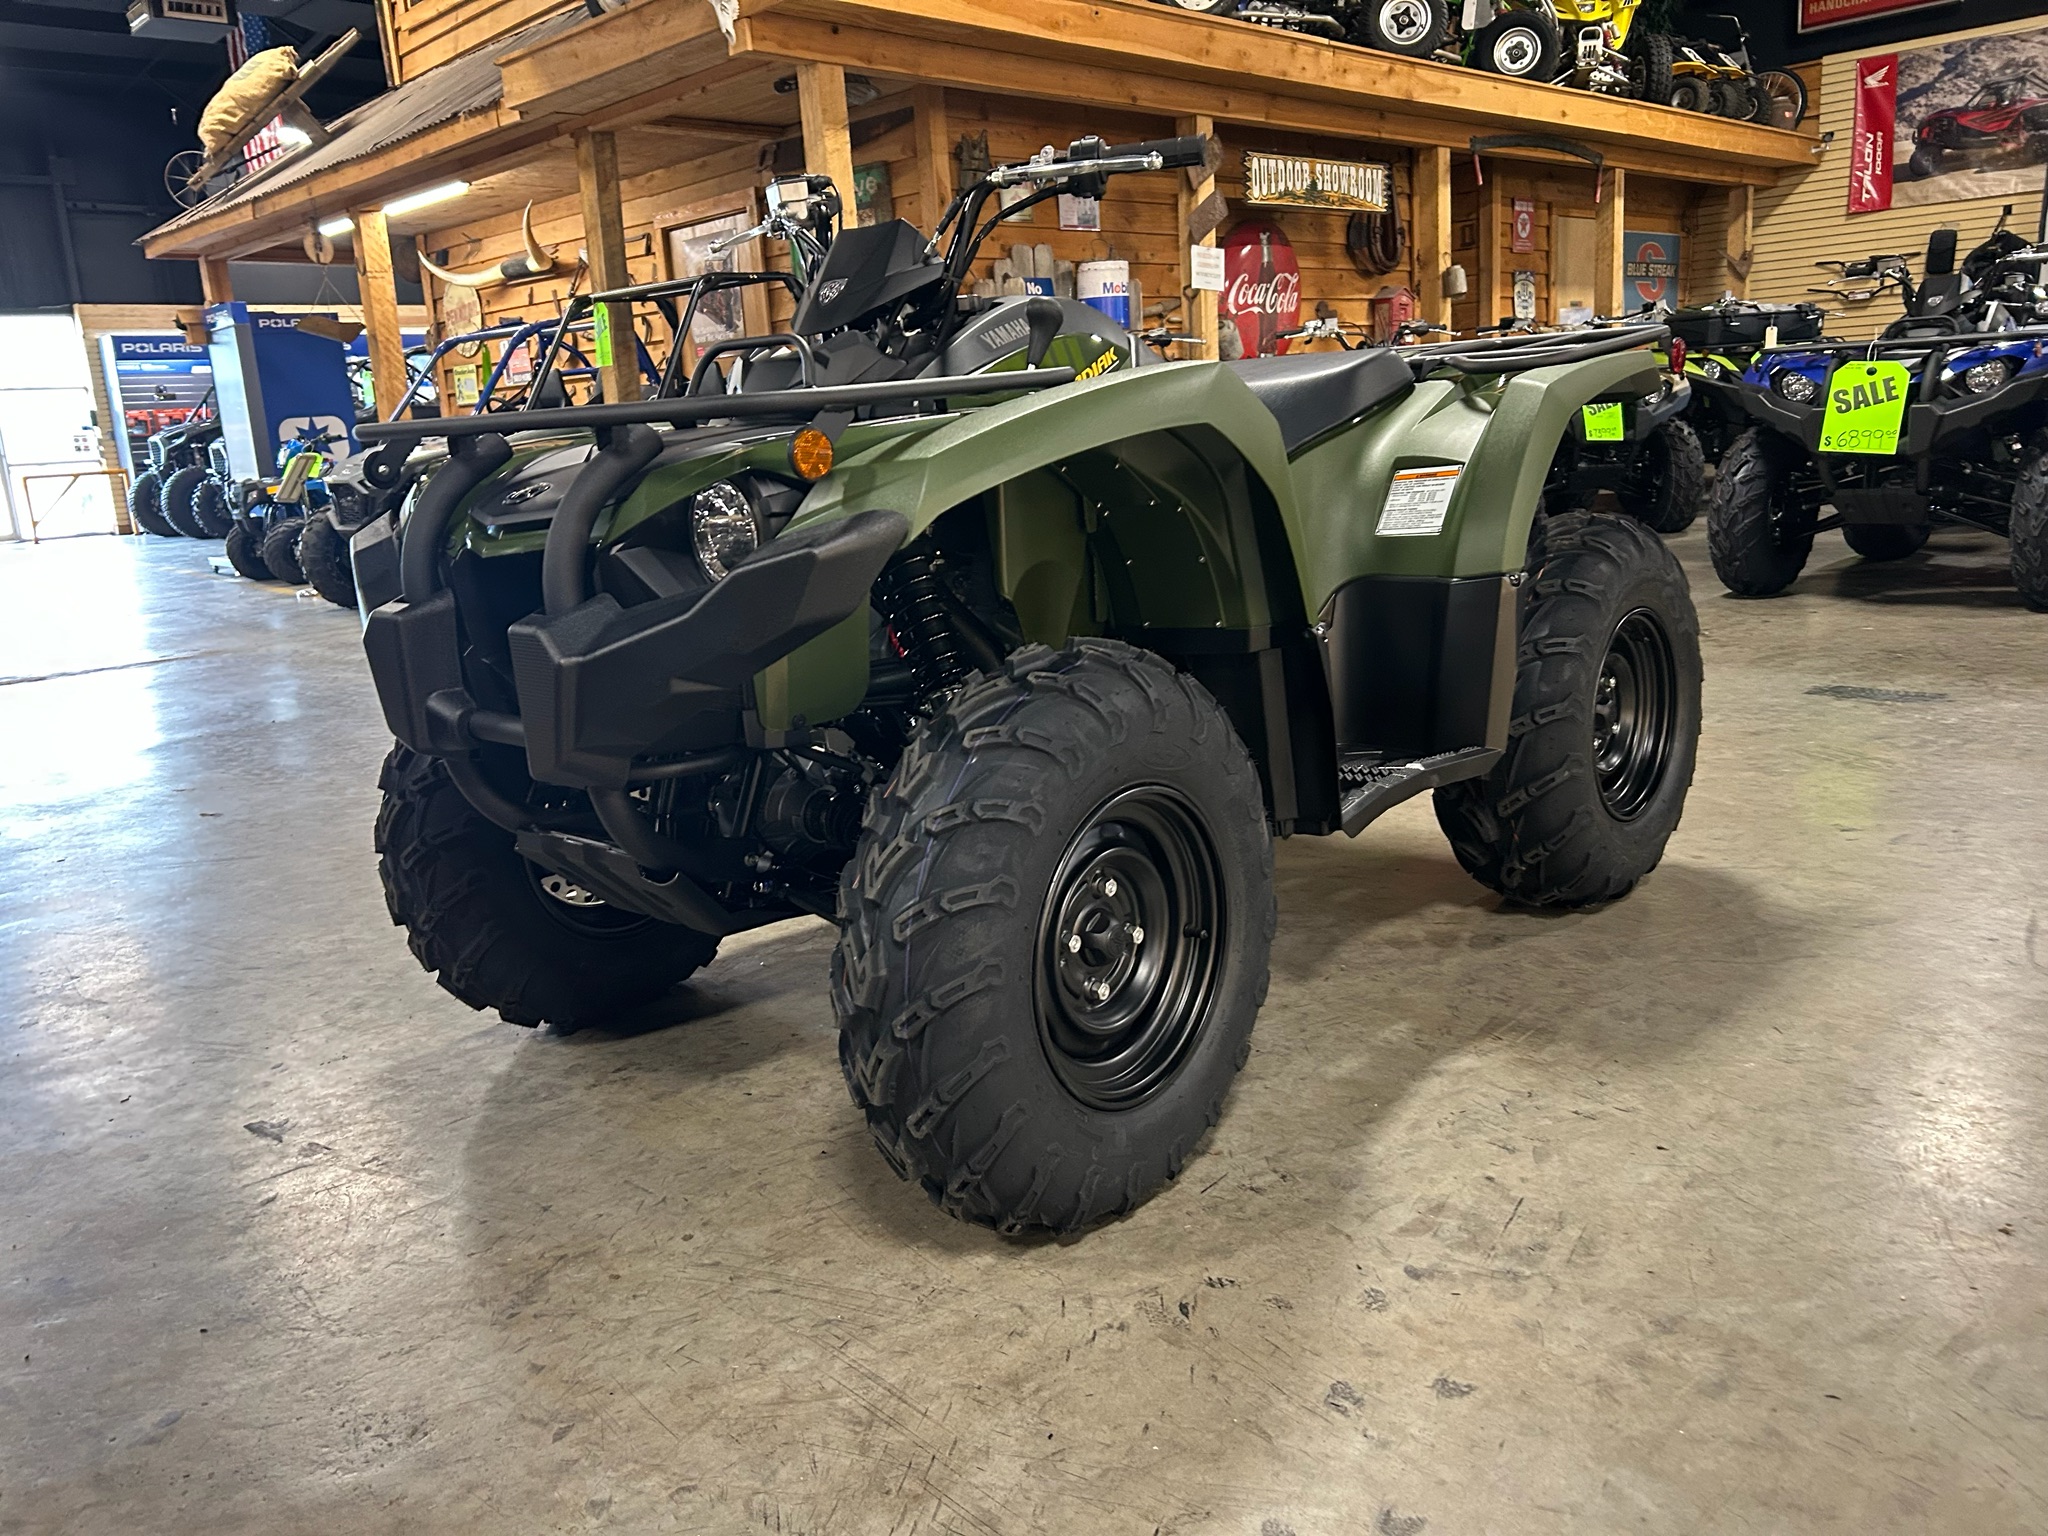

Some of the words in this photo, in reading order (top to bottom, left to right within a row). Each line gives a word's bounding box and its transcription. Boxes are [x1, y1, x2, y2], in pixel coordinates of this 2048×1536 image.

[1861, 132, 1879, 203] TALON
[1874, 131, 1884, 175] 1000R
[1251, 156, 1311, 199] OUTDOOR
[1315, 163, 1383, 207] SHOWROOM
[1027, 282, 1043, 295] No
[1627, 262, 1646, 276] BLUE
[1647, 263, 1676, 277] STREAK
[1228, 272, 1299, 314] Coca-Cola
[121, 341, 203, 354] POLARIS
[980, 317, 1031, 350] YAMAHA
[1833, 376, 1900, 414] SALE
